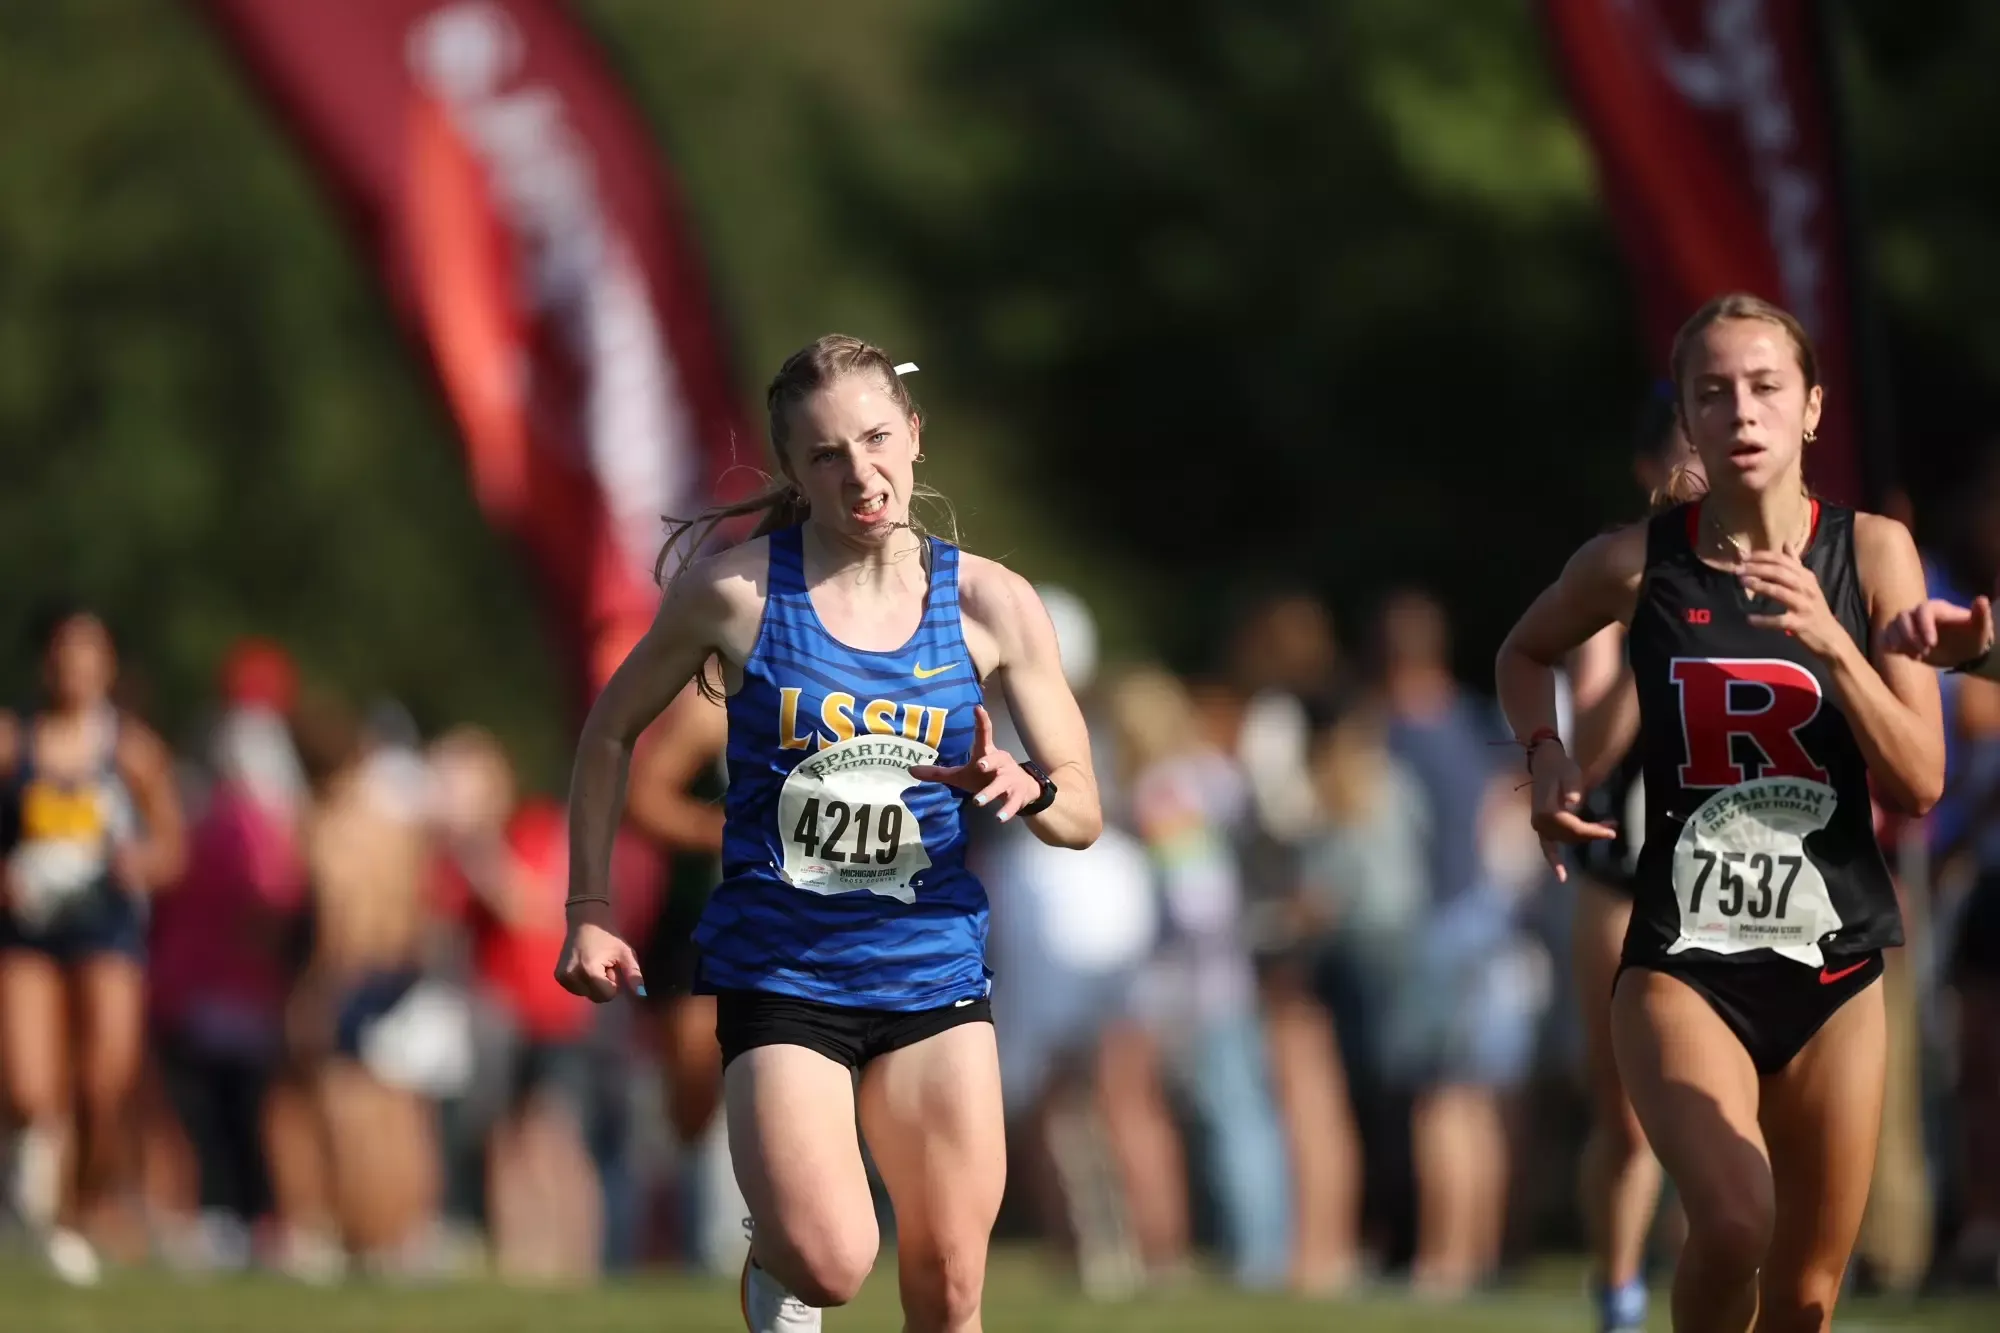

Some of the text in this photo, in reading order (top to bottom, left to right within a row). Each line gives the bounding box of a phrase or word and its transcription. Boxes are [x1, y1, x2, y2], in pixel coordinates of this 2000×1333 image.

[778, 687, 949, 751] LSSU
[1669, 657, 1830, 789] R
[809, 743, 925, 773] SPARTAN
[816, 758, 913, 783] INVITATIONA
[1702, 785, 1826, 823] SPARTAN
[1708, 800, 1822, 832] INVITATIONAL
[794, 797, 903, 866] 4219
[840, 868, 876, 878] MICHIGAN
[1688, 848, 1802, 920] 7537
